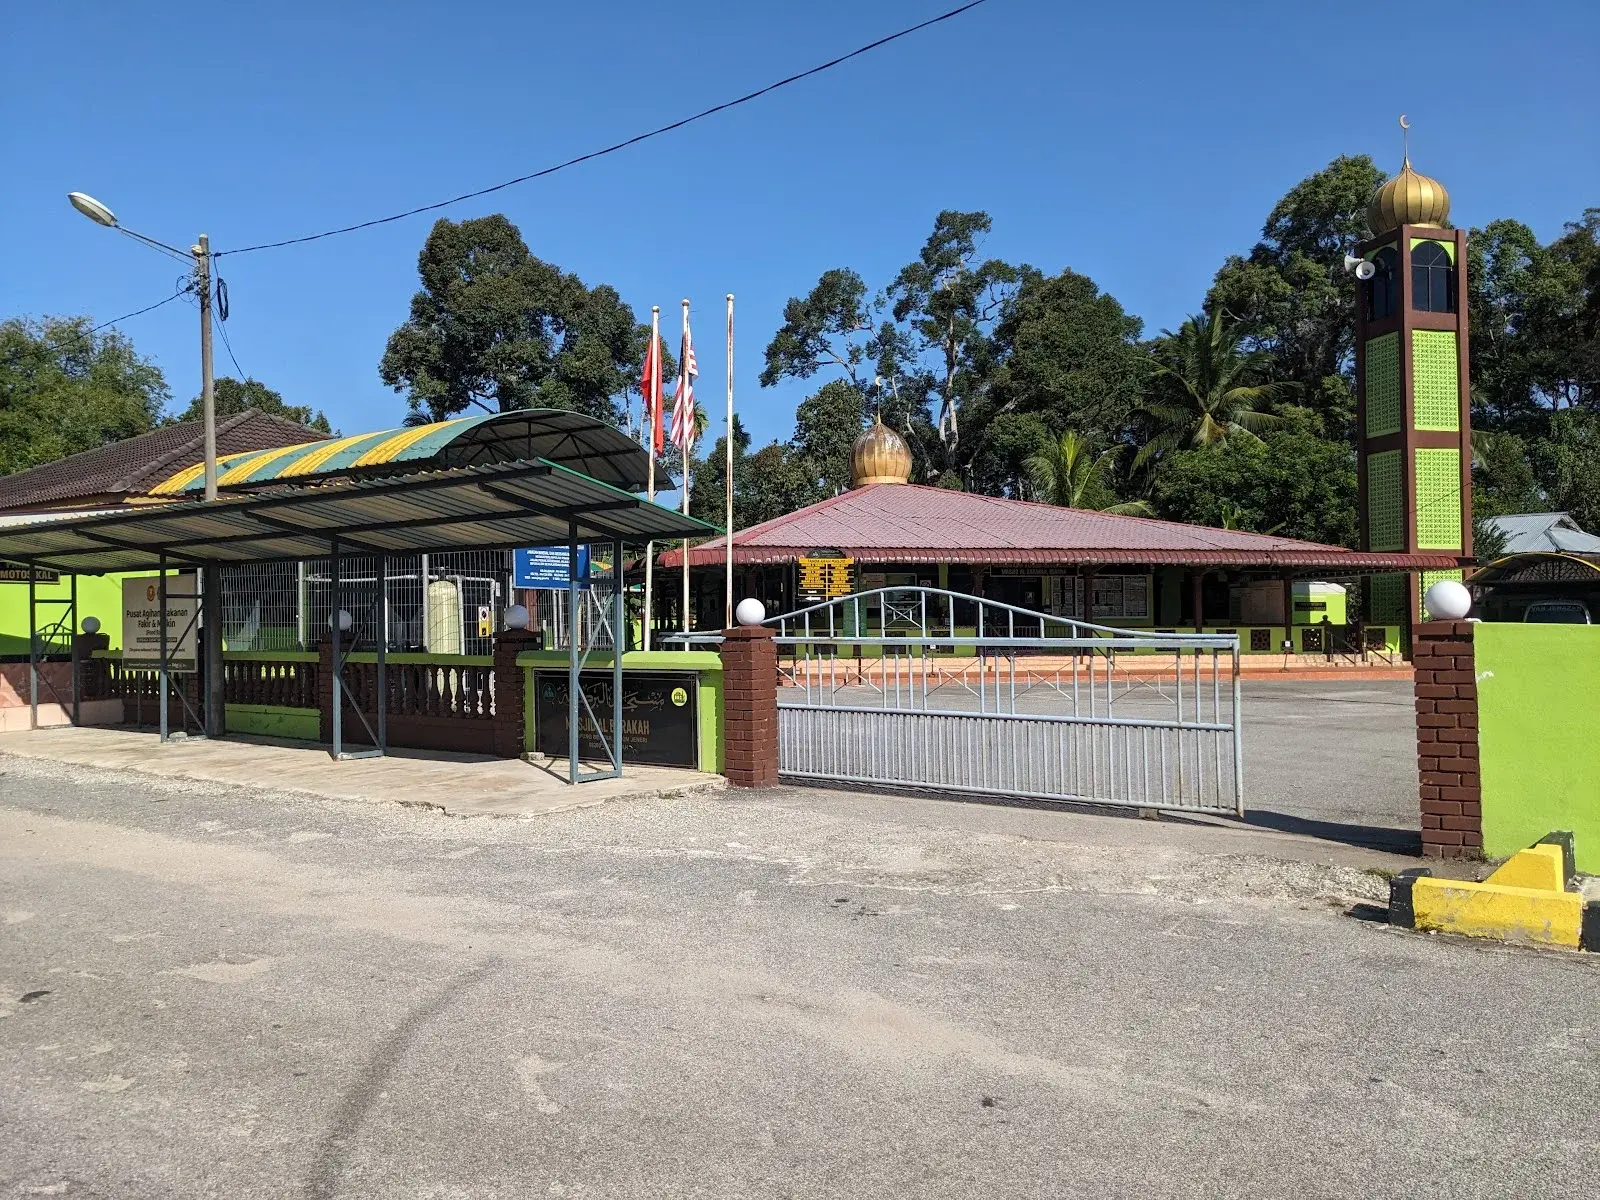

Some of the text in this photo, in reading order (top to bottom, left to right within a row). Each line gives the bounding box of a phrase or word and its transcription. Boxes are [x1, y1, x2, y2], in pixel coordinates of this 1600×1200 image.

[0, 570, 52, 579] MOTOSKAL
[126, 610, 142, 618] Pusat
[166, 608, 188, 617] akanan
[152, 620, 156, 628] &
[565, 716, 596, 732] MSJID
[609, 719, 650, 735] BRAKAH
